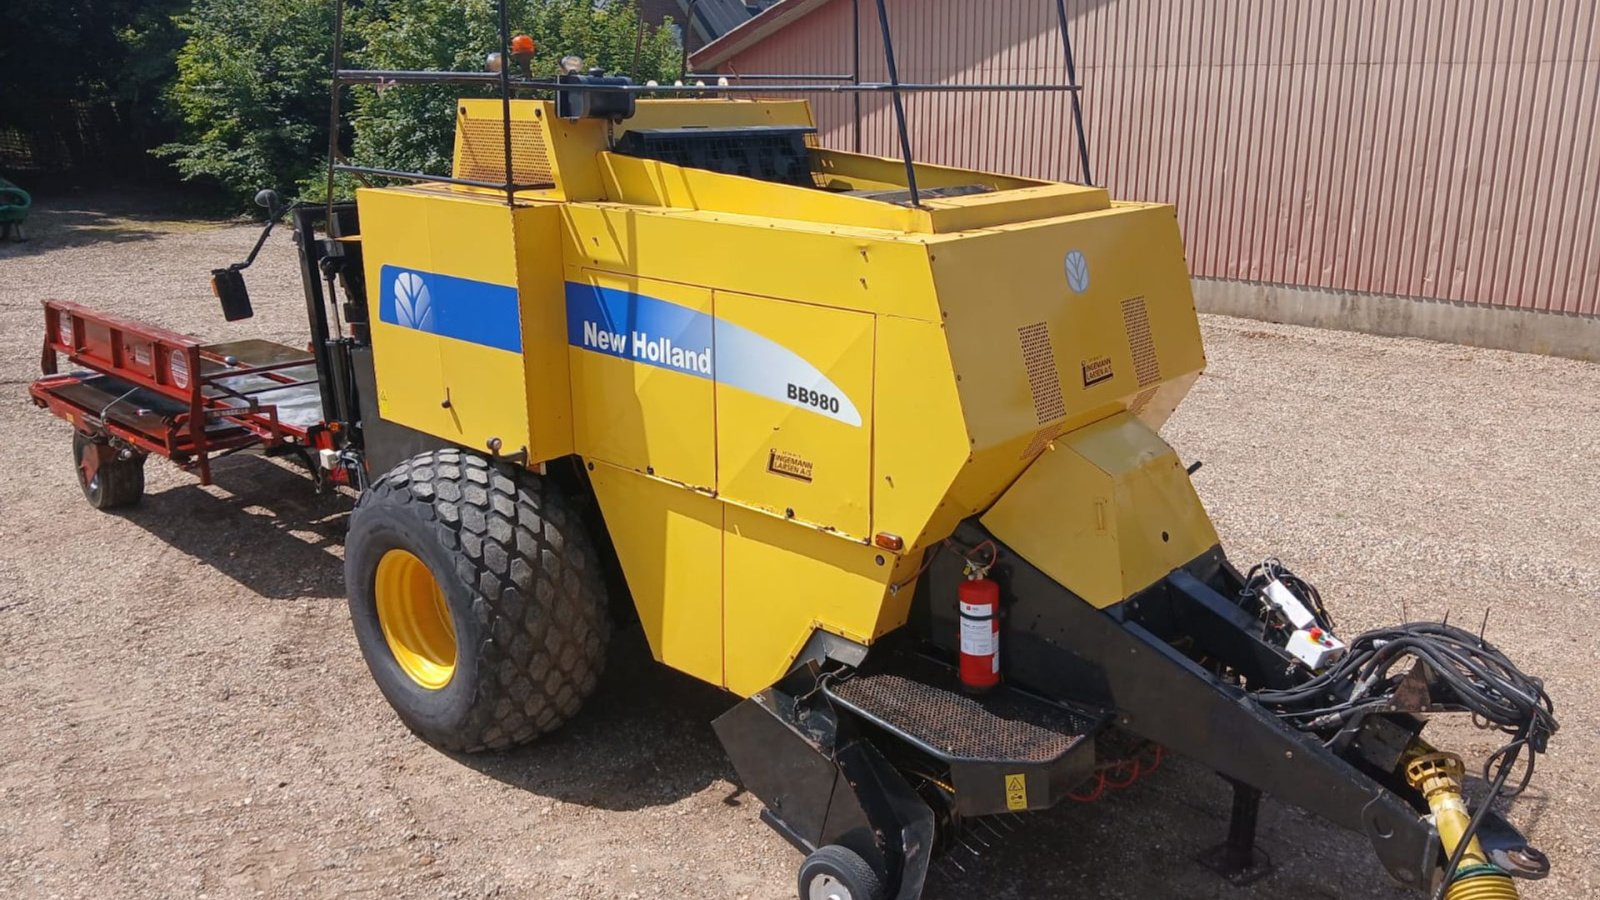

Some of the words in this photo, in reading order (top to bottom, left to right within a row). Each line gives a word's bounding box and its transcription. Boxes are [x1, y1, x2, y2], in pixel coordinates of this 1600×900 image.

[584, 320, 627, 354] New
[632, 330, 712, 375] Holland
[787, 383, 840, 414] BB980
[775, 461, 800, 474] LARSEN
[800, 467, 813, 477] A/S
